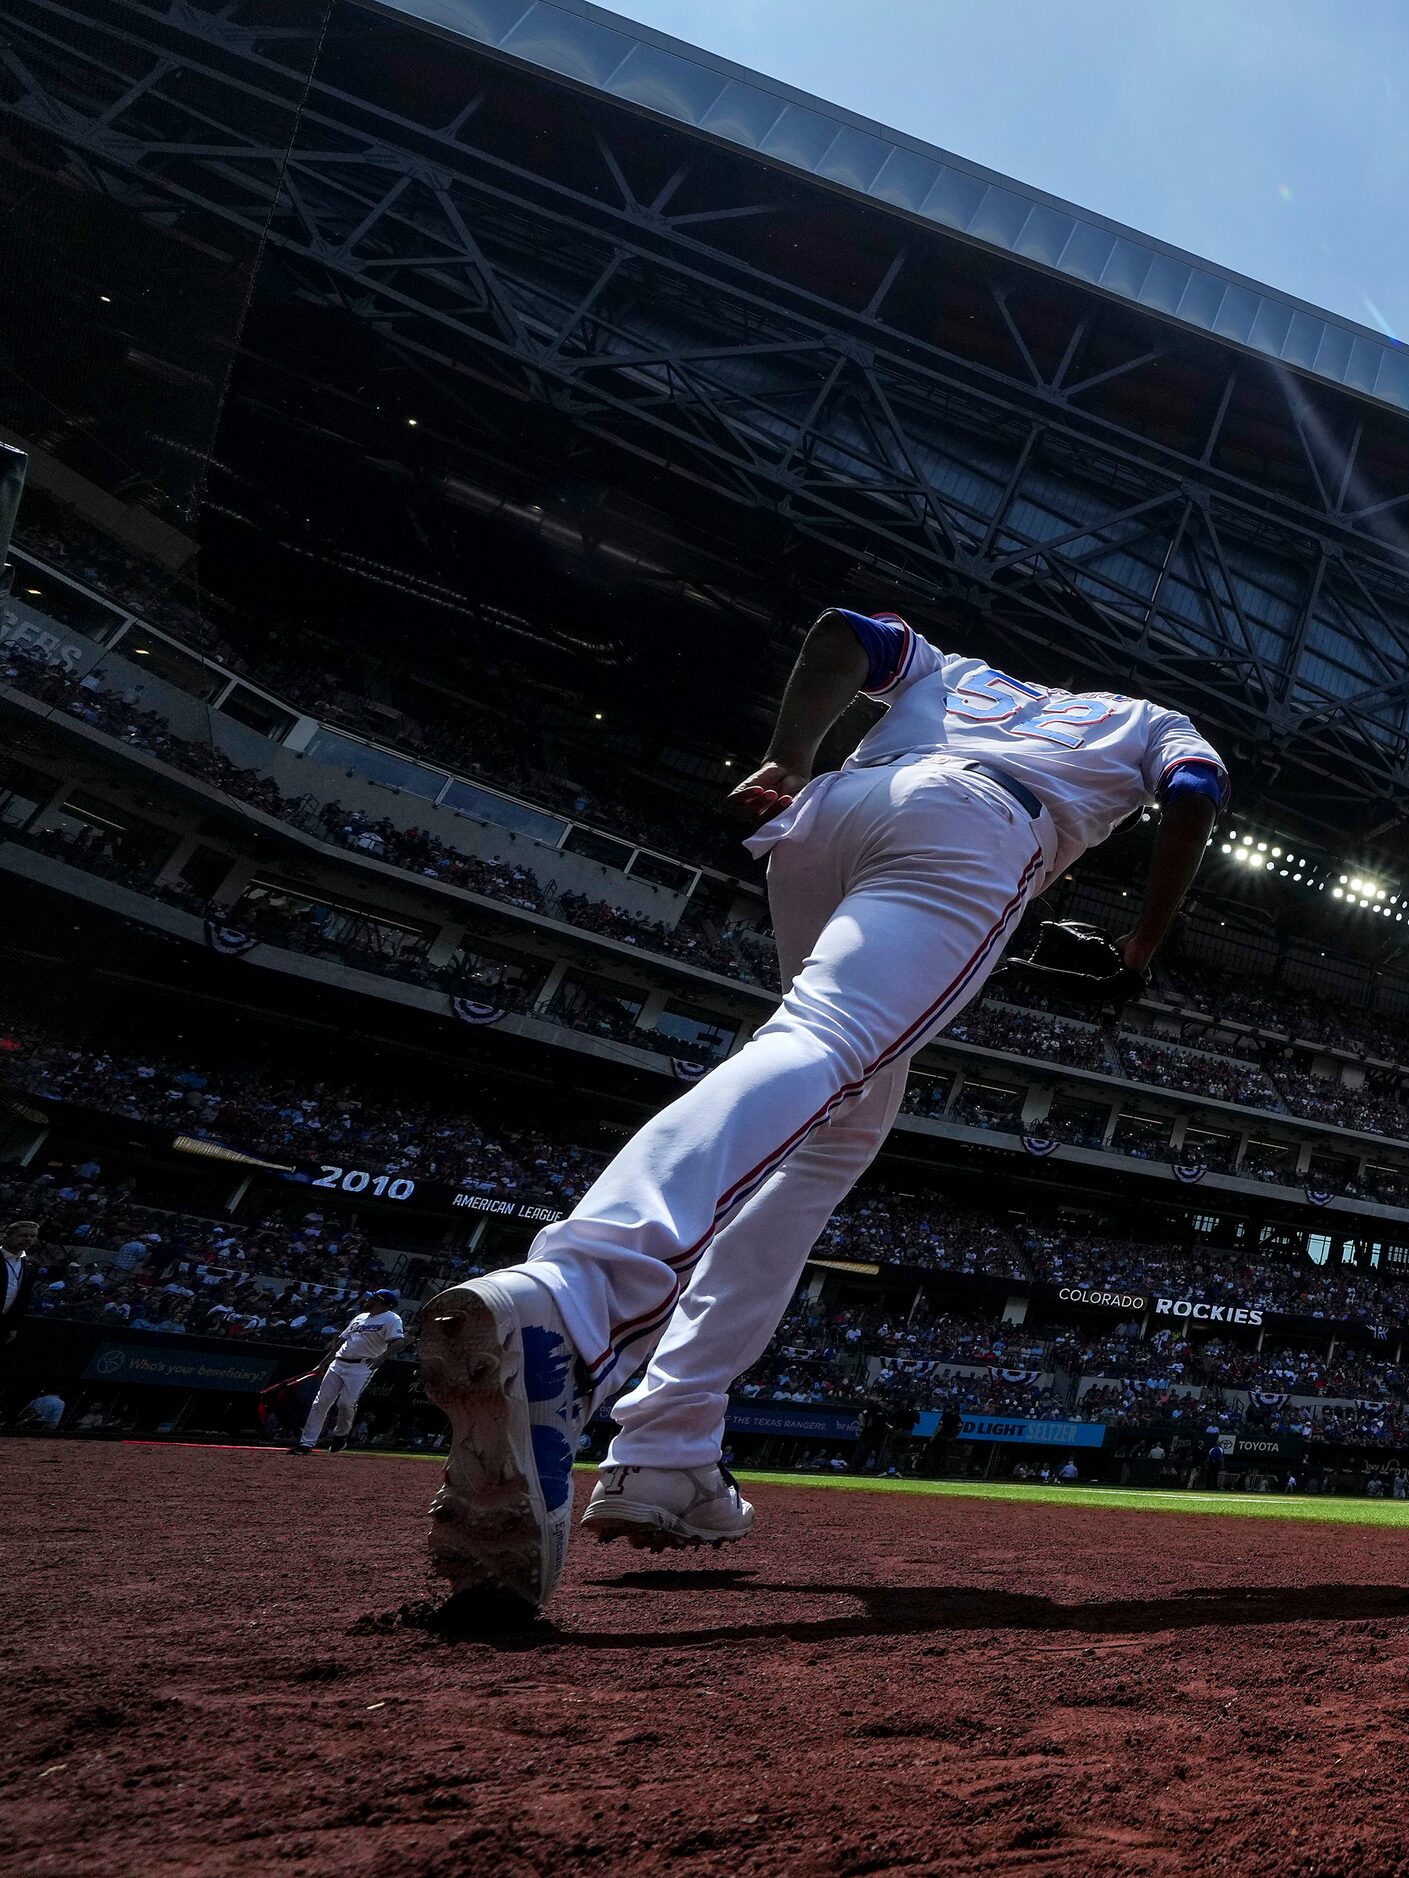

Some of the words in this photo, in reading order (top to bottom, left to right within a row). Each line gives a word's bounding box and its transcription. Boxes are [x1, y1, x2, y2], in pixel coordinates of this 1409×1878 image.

[944, 668, 1116, 749] 52
[312, 1165, 415, 1200] 2010
[452, 1193, 515, 1215] AMERICAN
[517, 1204, 564, 1223] LEAGUE
[1058, 1288, 1144, 1309] COLORADO
[1155, 1298, 1264, 1326] ROCKIES
[129, 1357, 164, 1371] Who's
[164, 1365, 193, 1376] your
[198, 1364, 267, 1382] beneficiary?
[732, 1415, 751, 1425] THE
[752, 1417, 781, 1428] TEXAS
[784, 1419, 827, 1430] RANGERS
[977, 1422, 1028, 1437] LIGHT
[1026, 1421, 1078, 1442] SELTZER
[1239, 1440, 1280, 1452] TOYOTA
